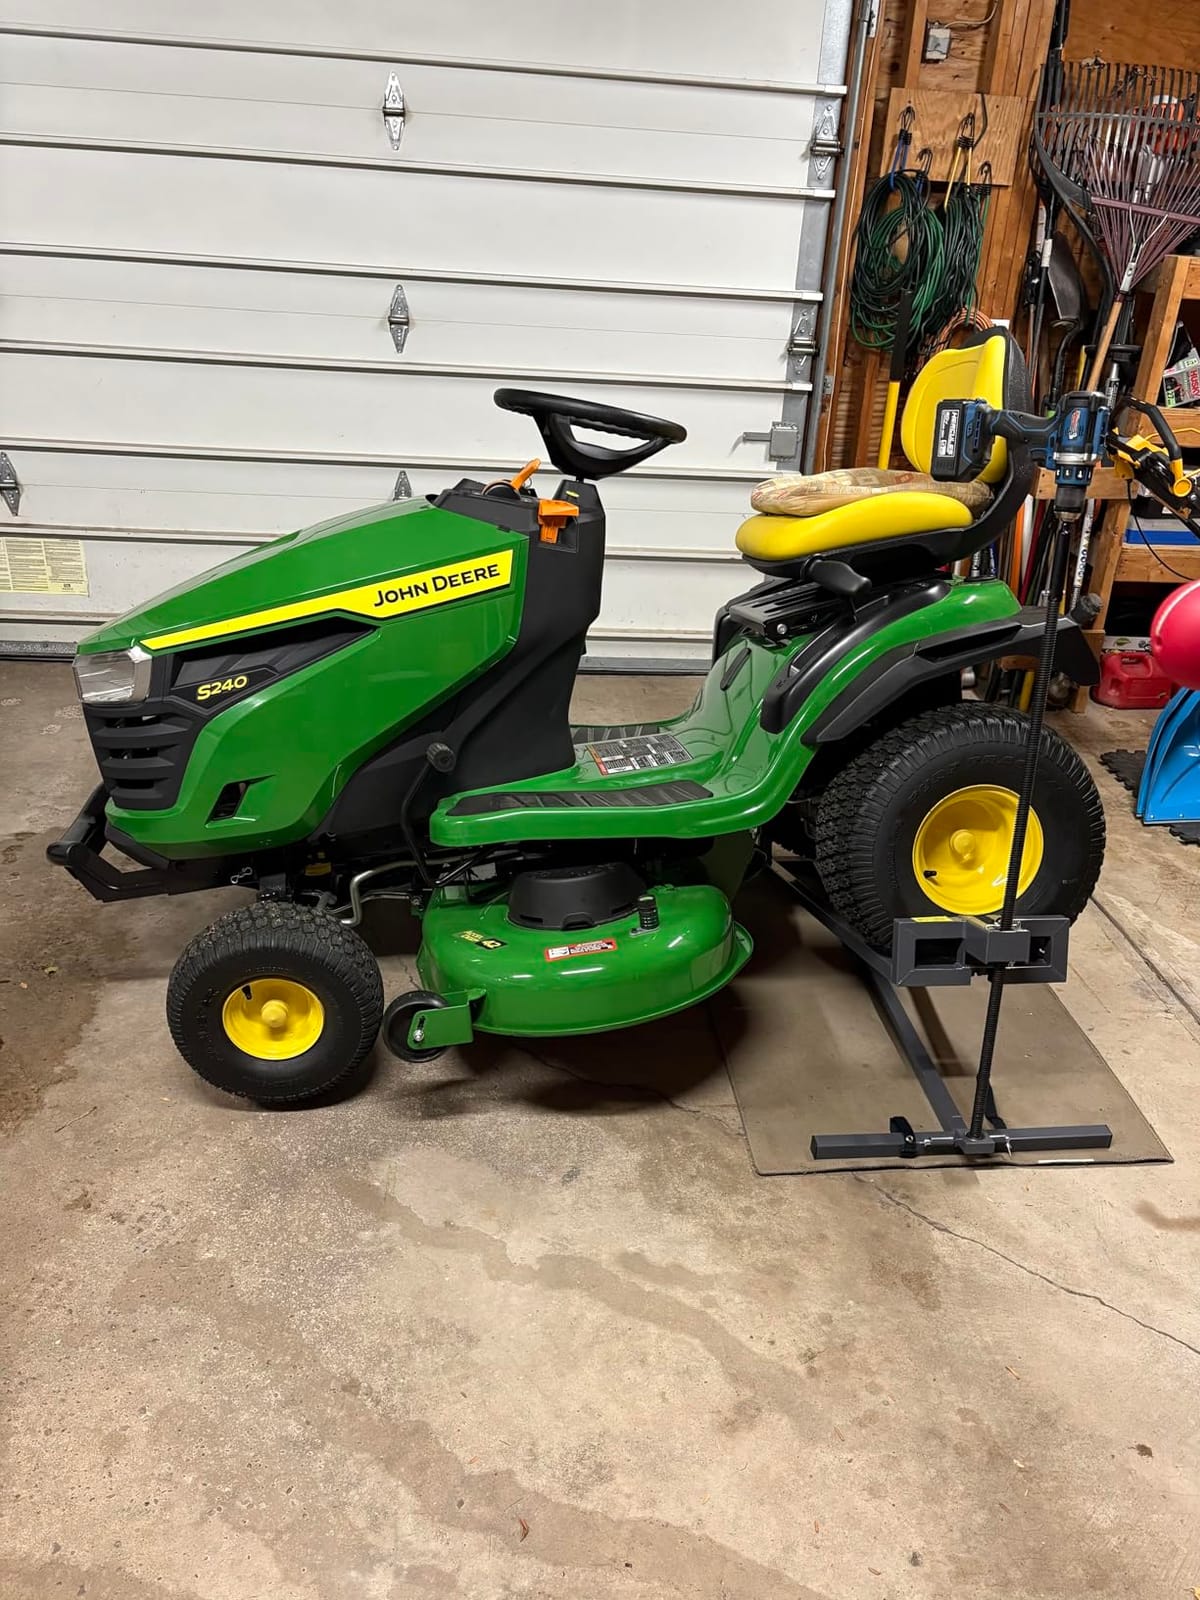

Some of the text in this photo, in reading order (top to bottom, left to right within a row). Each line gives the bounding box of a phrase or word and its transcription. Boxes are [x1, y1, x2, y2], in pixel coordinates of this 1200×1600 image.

[1190, 369, 1200, 396] HUSKY
[947, 411, 958, 456] HERCULES
[374, 564, 500, 607] JOHN DEERE
[197, 676, 248, 700] S240
